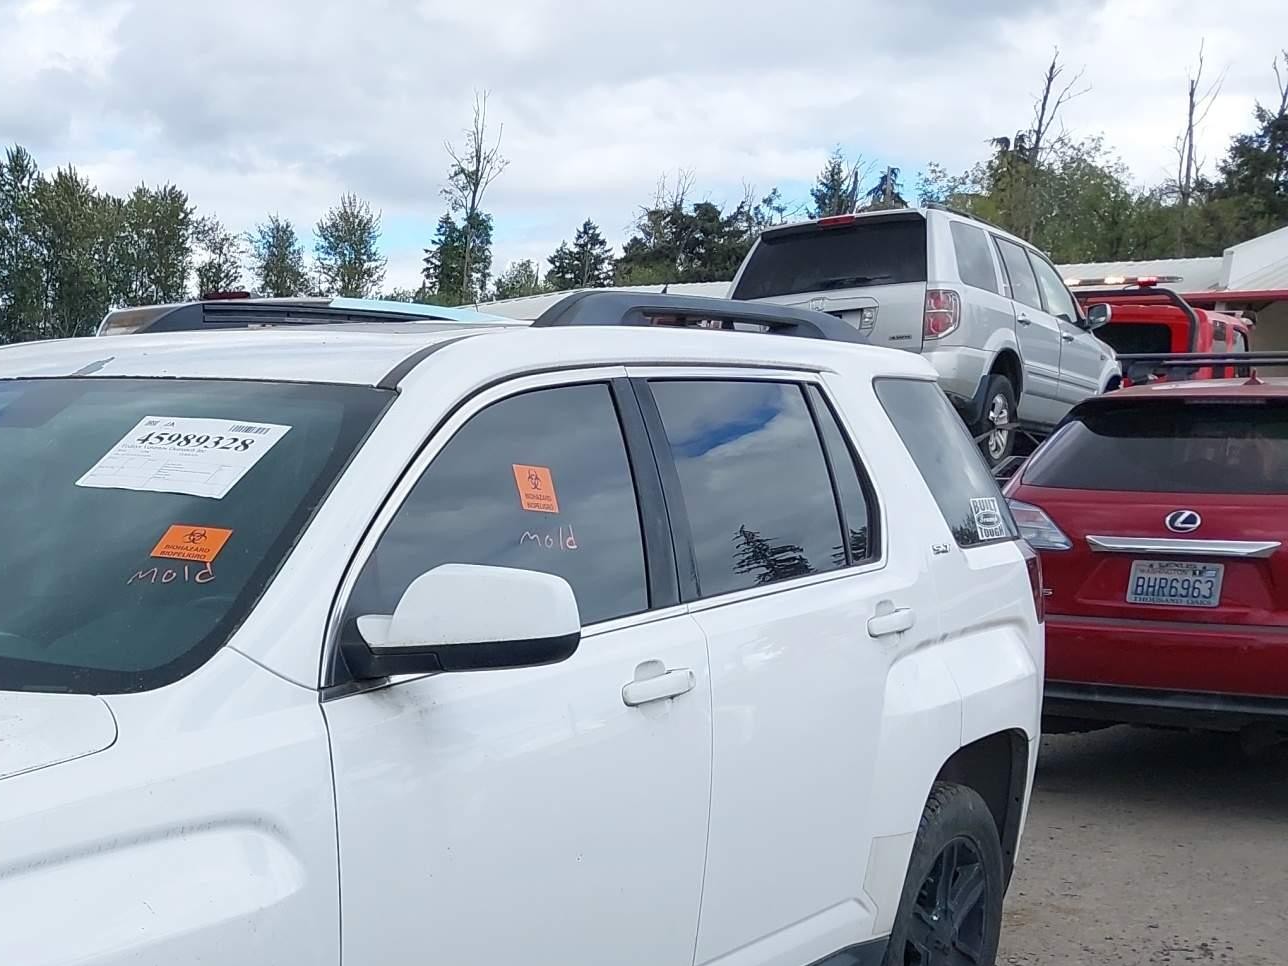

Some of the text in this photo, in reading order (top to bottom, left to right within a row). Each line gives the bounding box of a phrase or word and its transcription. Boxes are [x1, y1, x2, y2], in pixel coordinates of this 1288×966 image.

[136, 431, 255, 452] 45989328
[972, 499, 997, 515] BUILT
[979, 526, 1005, 539] TOUGH
[159, 550, 207, 560] BIOPELIGRO
[163, 544, 211, 554] BIOHAZARD
[1133, 576, 1214, 600] BHR6963
